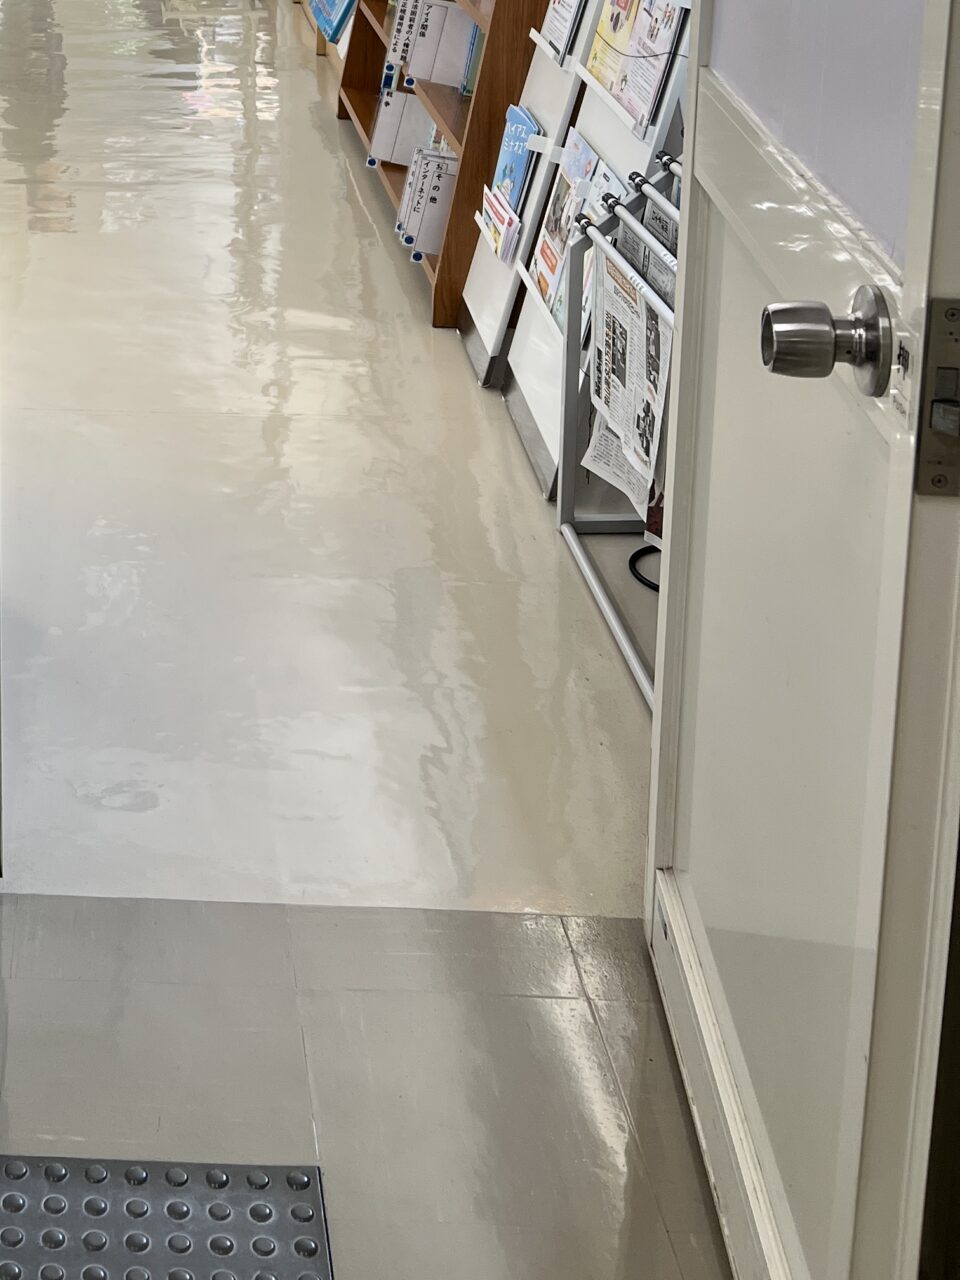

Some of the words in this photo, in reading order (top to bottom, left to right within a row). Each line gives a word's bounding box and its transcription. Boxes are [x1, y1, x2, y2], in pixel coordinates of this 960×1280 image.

[413, 161, 431, 214] インターネットに
